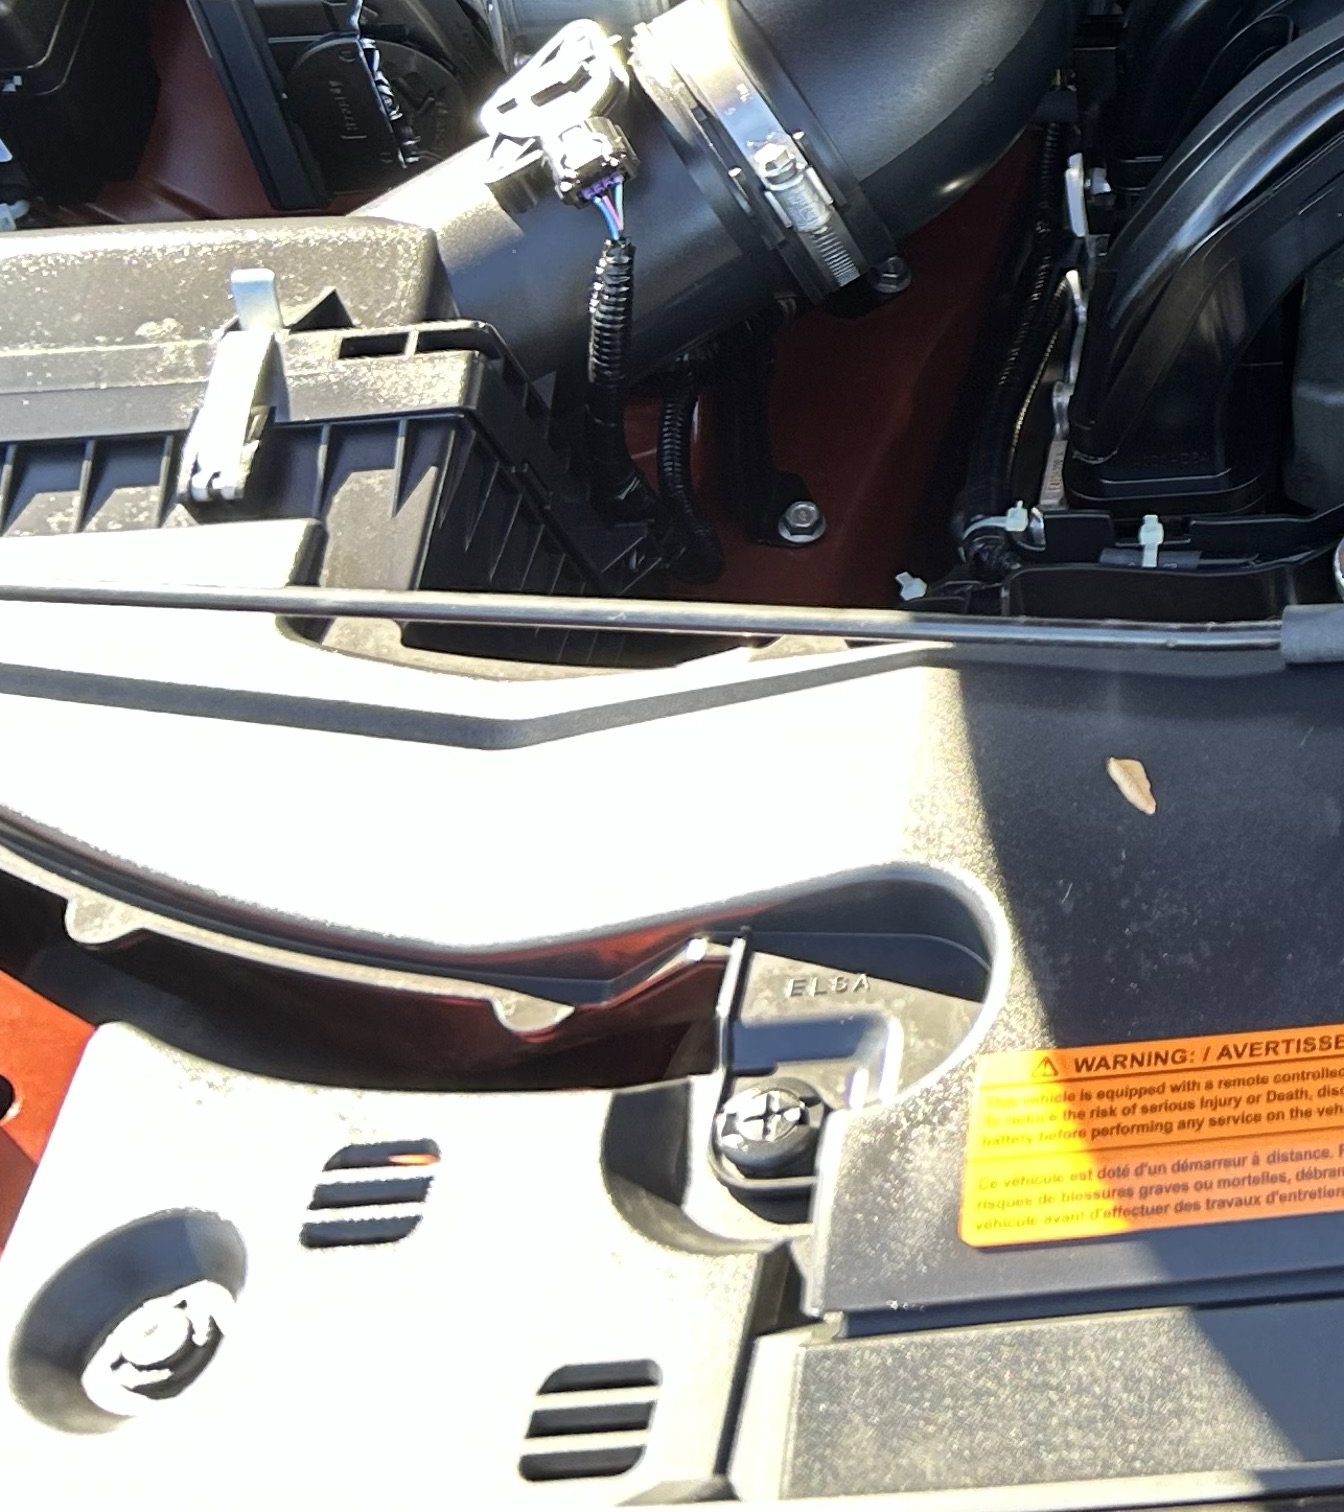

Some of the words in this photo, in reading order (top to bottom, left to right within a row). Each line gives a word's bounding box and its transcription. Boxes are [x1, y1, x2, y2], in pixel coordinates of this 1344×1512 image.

[1074, 1049, 1196, 1073] WARNING:
[1202, 1046, 1212, 1063] /
[1023, 1090, 1075, 1107] vehicle
[1079, 1089, 1093, 1103] is
[1096, 1081, 1167, 1104] equipped
[1169, 1079, 1201, 1094] with
[1217, 1073, 1270, 1090] remote
[1062, 1105, 1086, 1122] the
[1089, 1102, 1118, 1119] risk
[1121, 1099, 1138, 1115] of
[1140, 1097, 1197, 1114] serious
[1246, 1092, 1262, 1105] or
[1265, 1086, 1314, 1103] Death,
[1039, 1126, 1088, 1143] before
[1090, 1119, 1174, 1143] performing
[1176, 1118, 1204, 1134] any
[1207, 1110, 1262, 1128] service
[1265, 1109, 1286, 1123] on
[1289, 1102, 1313, 1119] the
[1069, 1166, 1093, 1182] est
[1097, 1161, 1131, 1181] doté
[1134, 1157, 1168, 1177] d'un
[1171, 1150, 1249, 1174] démarreur
[1265, 1146, 1335, 1167] distance.
[1060, 1185, 1135, 1204] blessures
[1137, 1182, 1190, 1201] graves
[1192, 1178, 1214, 1193] ou
[1217, 1170, 1292, 1191] mortelles,
[1089, 1201, 1169, 1221] d'effectuer
[1173, 1196, 1202, 1214] des
[1205, 1191, 1262, 1210] travaux
[1265, 1182, 1343, 1205] d'entretien
